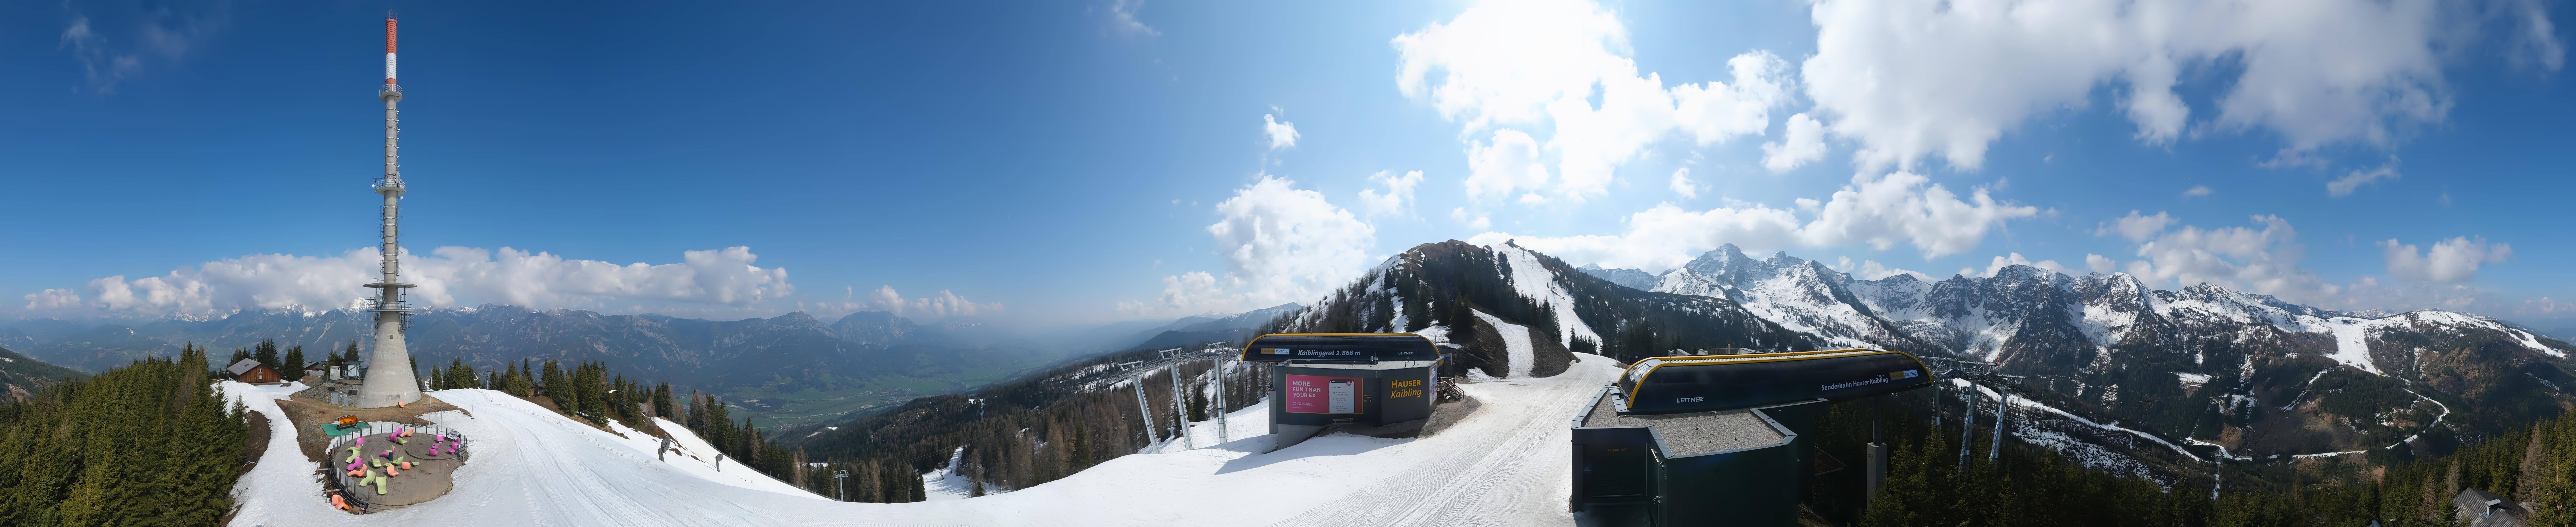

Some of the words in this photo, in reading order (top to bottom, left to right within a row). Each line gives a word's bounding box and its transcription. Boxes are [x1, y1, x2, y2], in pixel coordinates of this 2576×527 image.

[1391, 380, 1421, 388] HAUSER
[1821, 382, 1852, 391] Senderbahn
[1391, 388, 1421, 398] Kaibling
